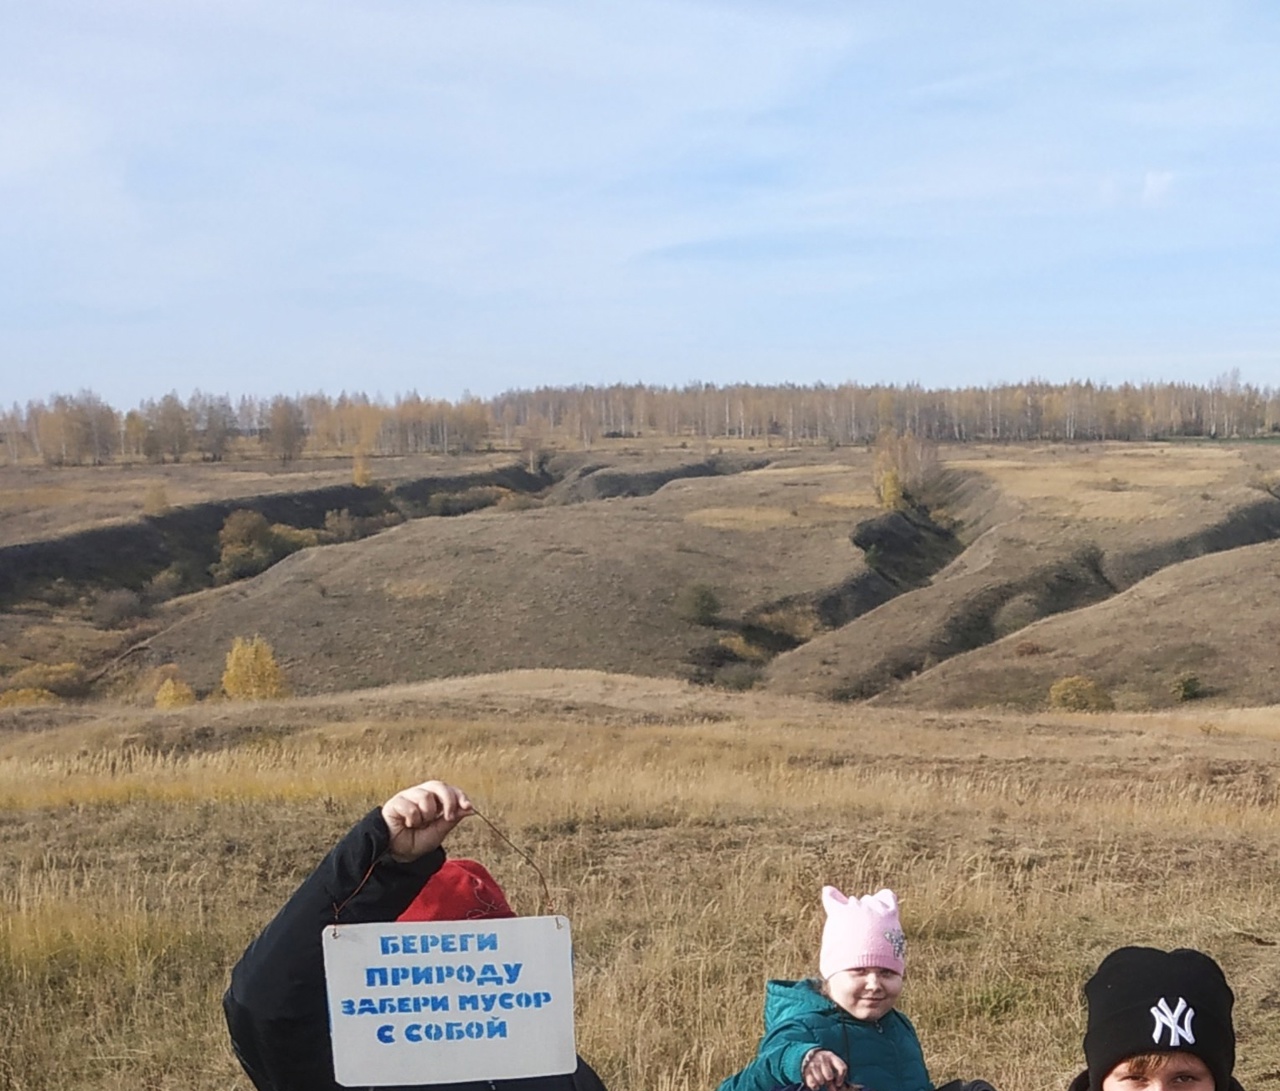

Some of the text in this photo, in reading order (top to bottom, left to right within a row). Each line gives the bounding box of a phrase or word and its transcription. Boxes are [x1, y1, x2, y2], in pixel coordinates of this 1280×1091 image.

[380, 933, 499, 955] БЕРЕГИ
[365, 963, 523, 987] ПРИРОДУ
[341, 992, 552, 1015] ЗАБЕРИ МУСОР
[376, 1016, 508, 1044] С СОБОЙ
[1149, 996, 1196, 1047] NY
